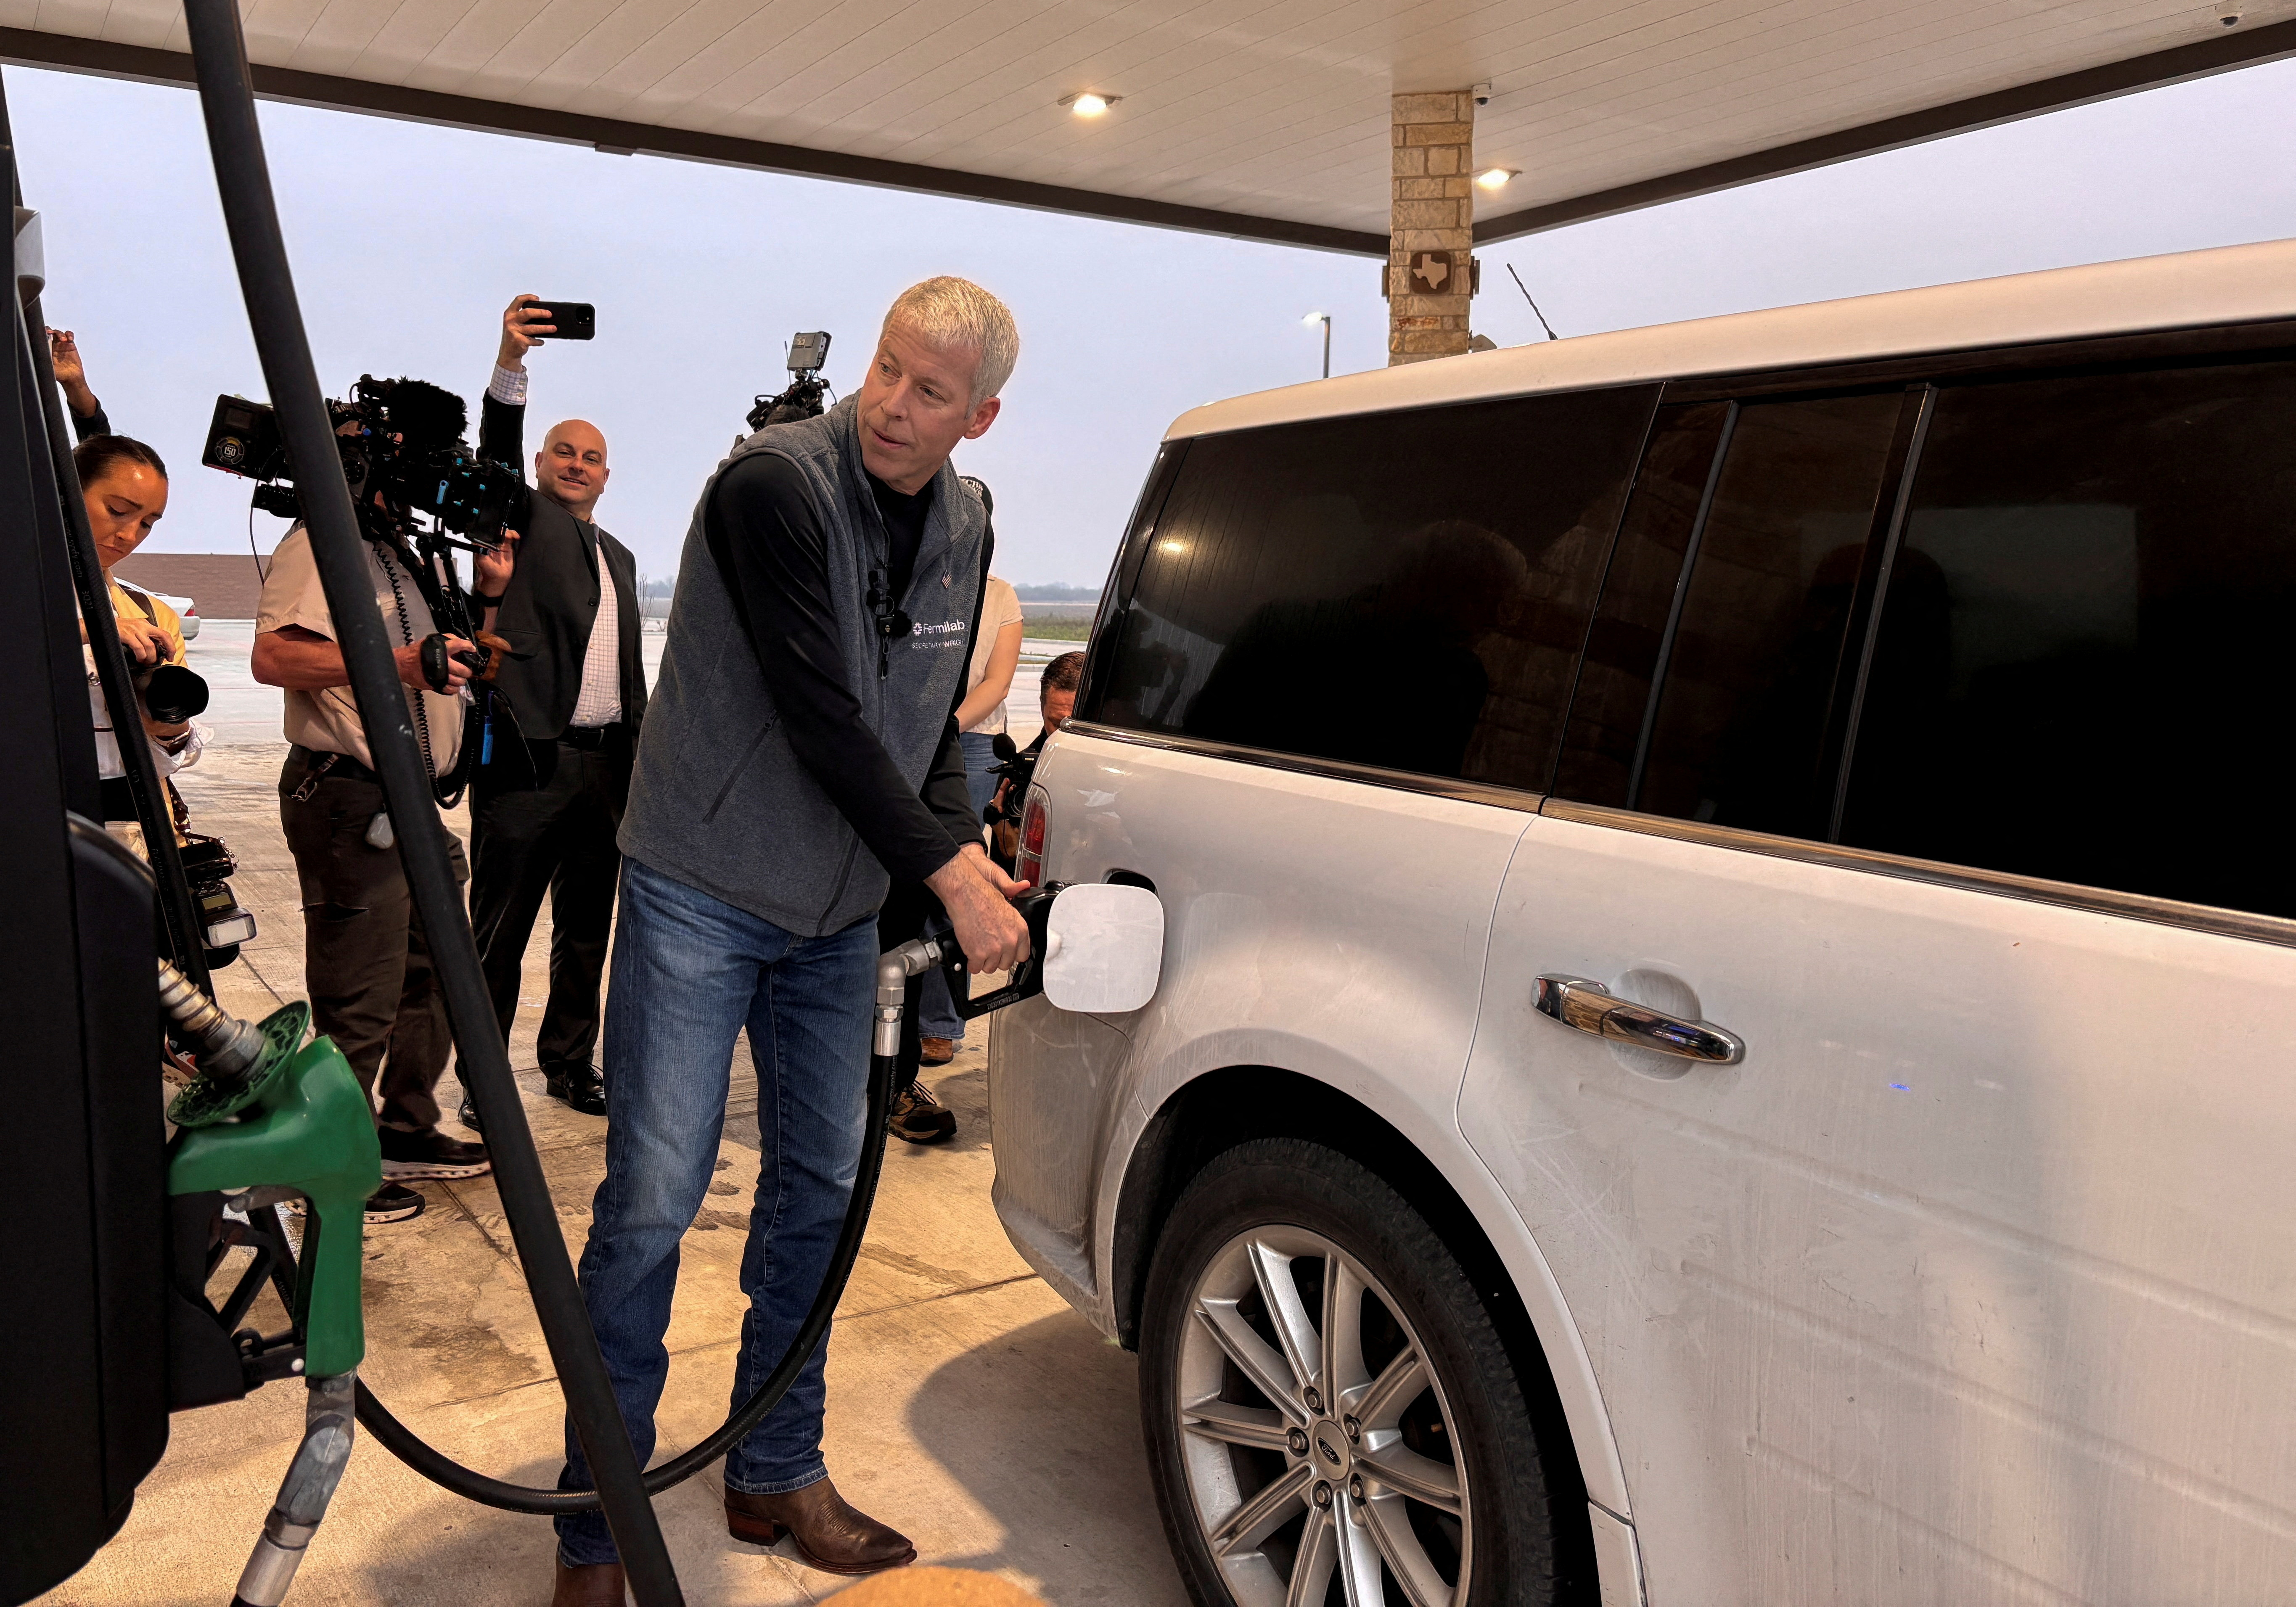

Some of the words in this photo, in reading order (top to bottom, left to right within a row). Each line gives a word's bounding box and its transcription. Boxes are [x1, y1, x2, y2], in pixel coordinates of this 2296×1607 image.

[224, 446, 236, 456] 150
[923, 619, 965, 634] Fermilab
[943, 639, 964, 648] WRIGH
[1322, 1444, 1336, 1459] Ford
